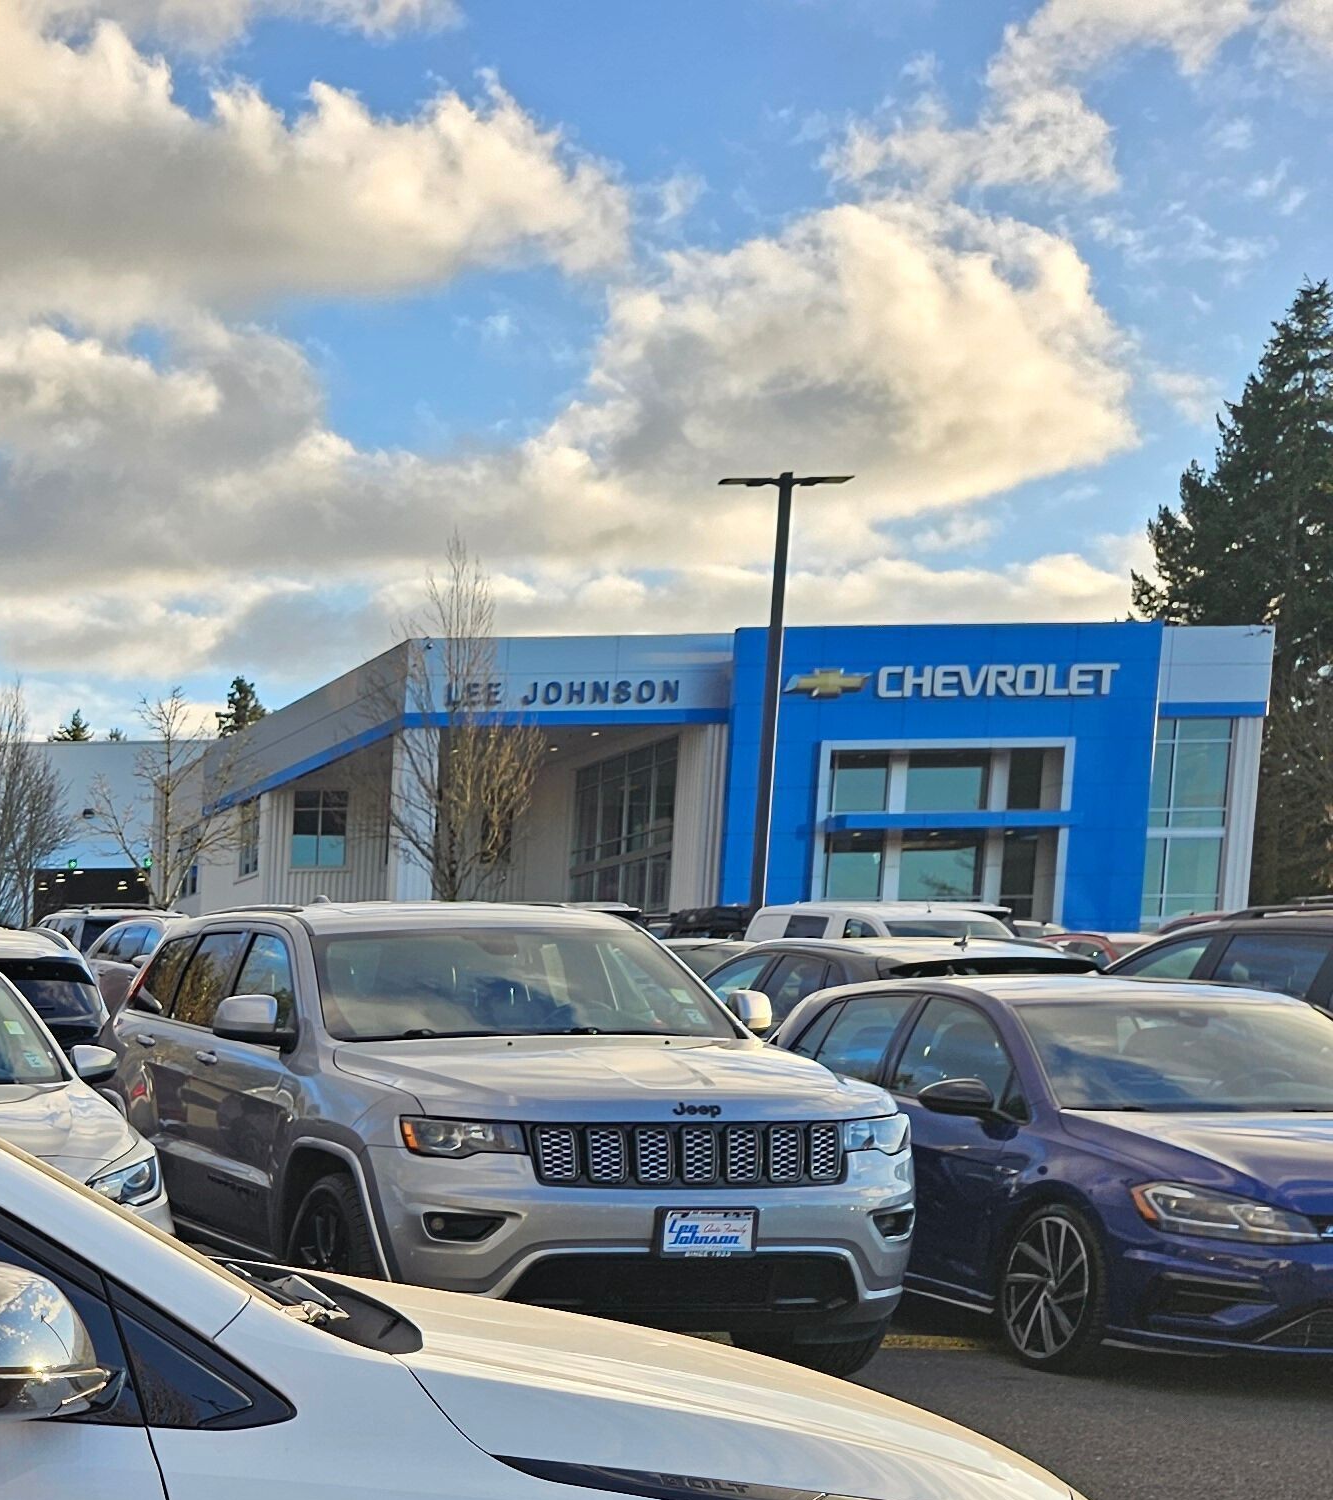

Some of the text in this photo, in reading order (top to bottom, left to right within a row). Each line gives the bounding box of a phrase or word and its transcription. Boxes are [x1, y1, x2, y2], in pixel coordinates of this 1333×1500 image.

[877, 662, 1121, 698] CHEVROLET
[445, 679, 681, 706] LEE JOHNSON
[672, 1102, 722, 1119] Jeep
[668, 1230, 741, 1245] Johnson
